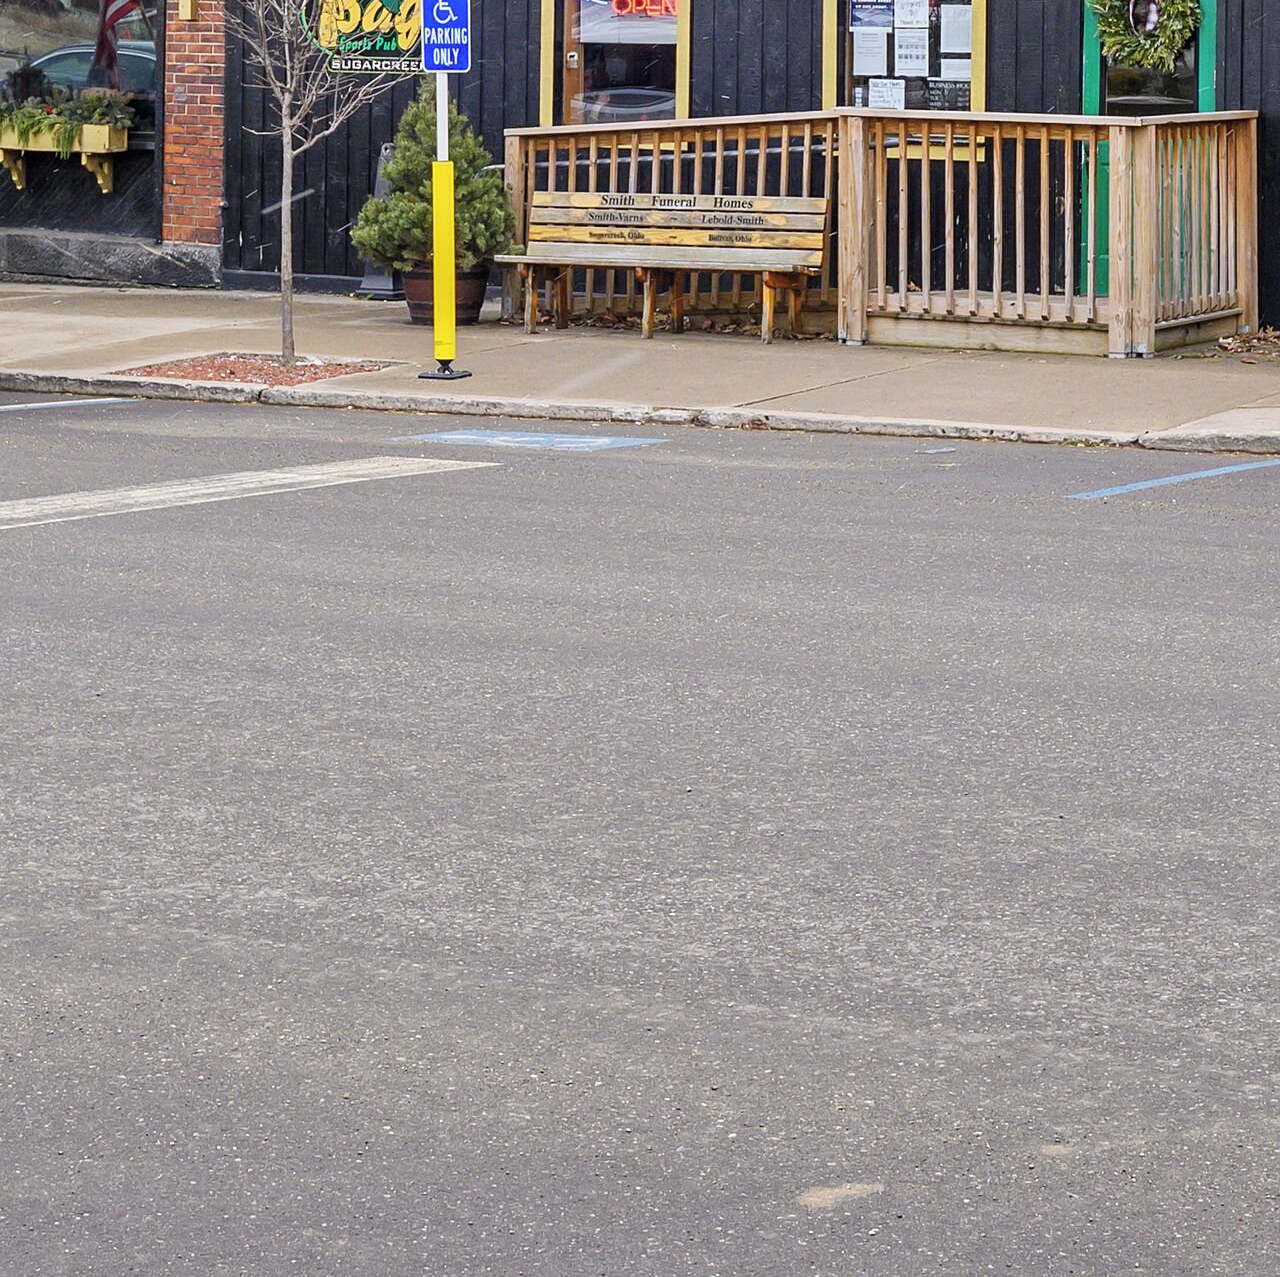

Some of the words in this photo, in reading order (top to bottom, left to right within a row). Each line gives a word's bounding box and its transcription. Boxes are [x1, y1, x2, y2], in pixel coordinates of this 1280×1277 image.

[376, 36, 397, 51] Pub
[424, 27, 468, 45] PARKING
[433, 48, 460, 66] ONLY
[331, 60, 423, 70] SUGARCREE
[601, 194, 635, 206] Smith
[651, 195, 697, 207] Funeral
[713, 197, 754, 209] Homes
[702, 215, 764, 226] Lebold-Smith
